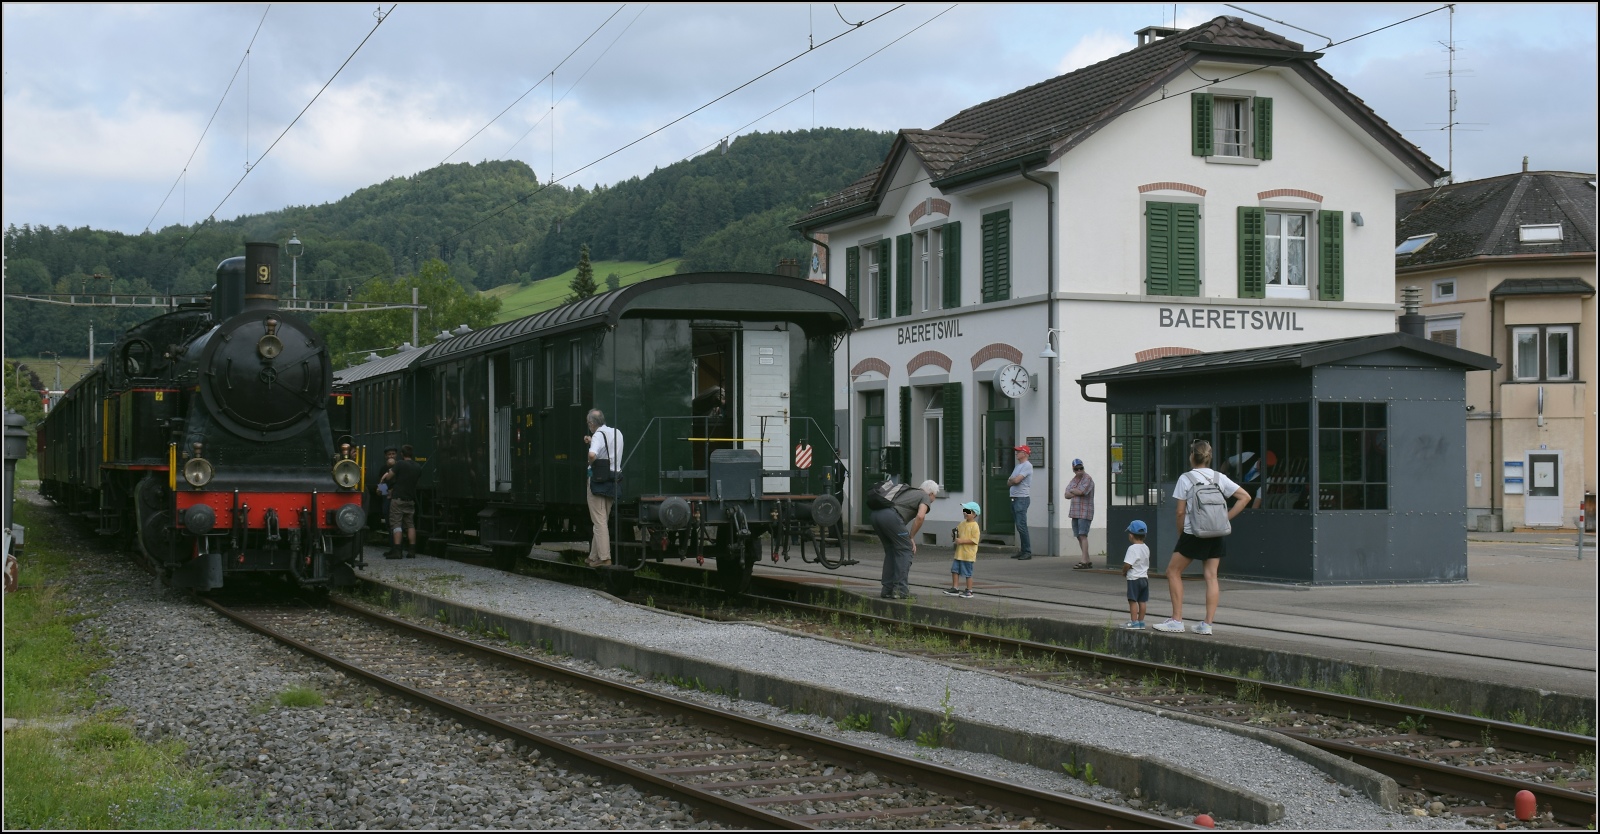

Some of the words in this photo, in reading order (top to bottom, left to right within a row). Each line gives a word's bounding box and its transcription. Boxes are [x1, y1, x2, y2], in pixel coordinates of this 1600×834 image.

[259, 265, 269, 281] 9
[1159, 307, 1304, 331] BAERETSWIL
[897, 319, 963, 345] BAERETSWIL
